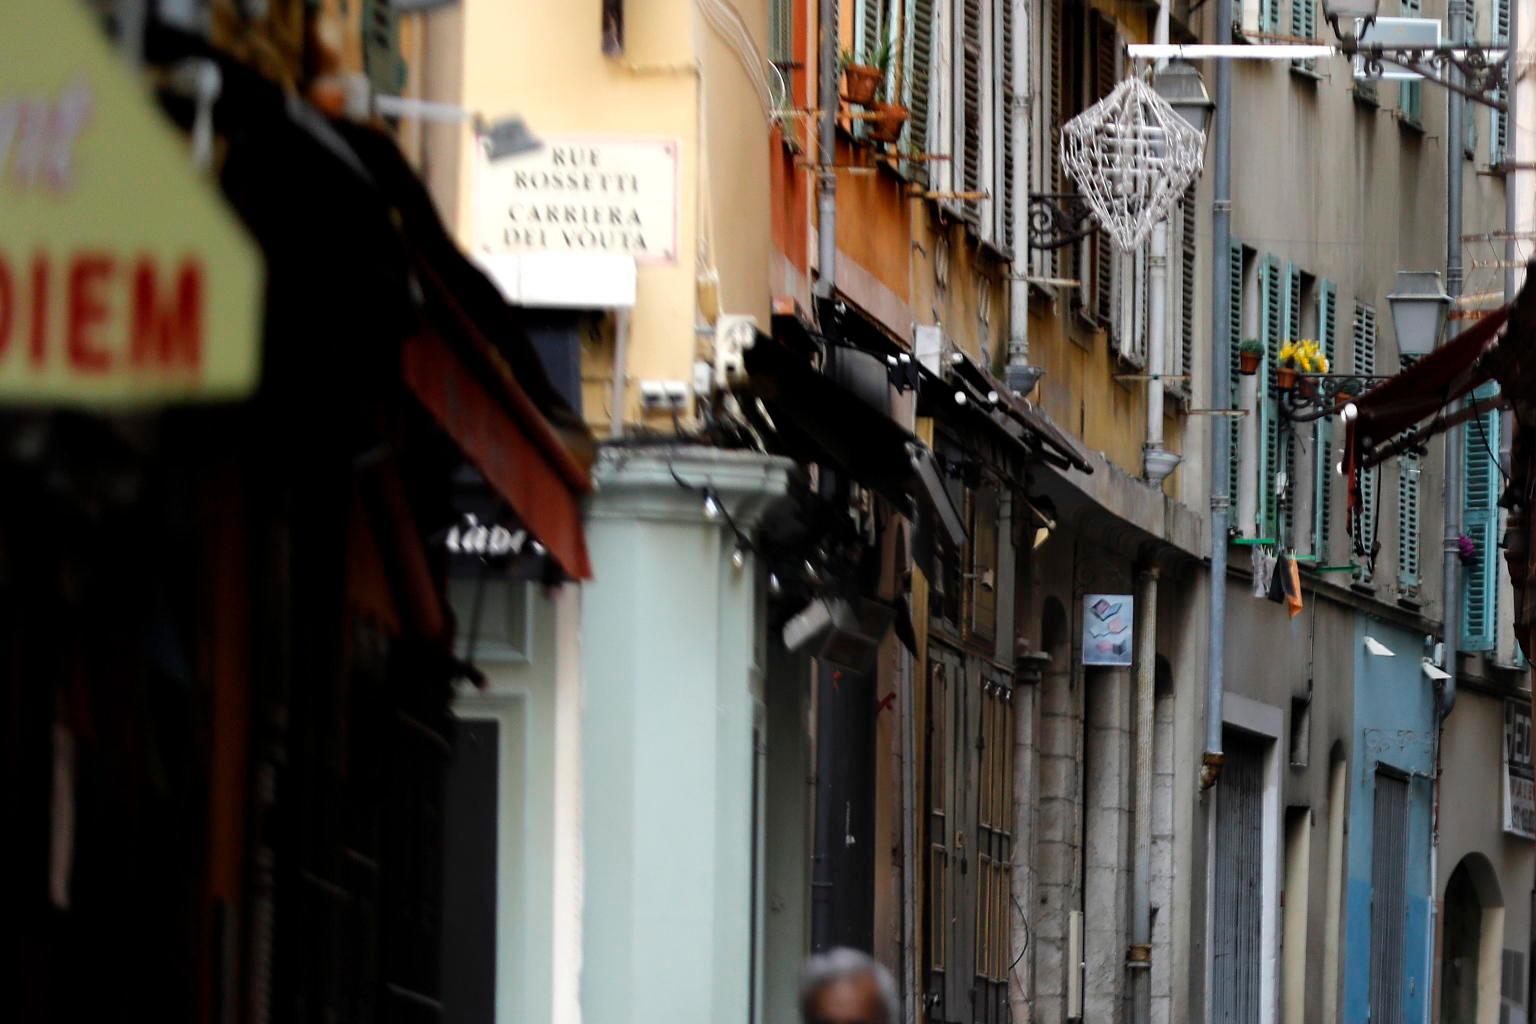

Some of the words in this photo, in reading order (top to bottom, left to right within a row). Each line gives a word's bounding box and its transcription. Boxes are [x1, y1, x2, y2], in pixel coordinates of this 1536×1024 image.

[552, 147, 600, 167] RUE
[514, 170, 639, 192] ROSSETTI
[507, 203, 642, 226] CARRIERA
